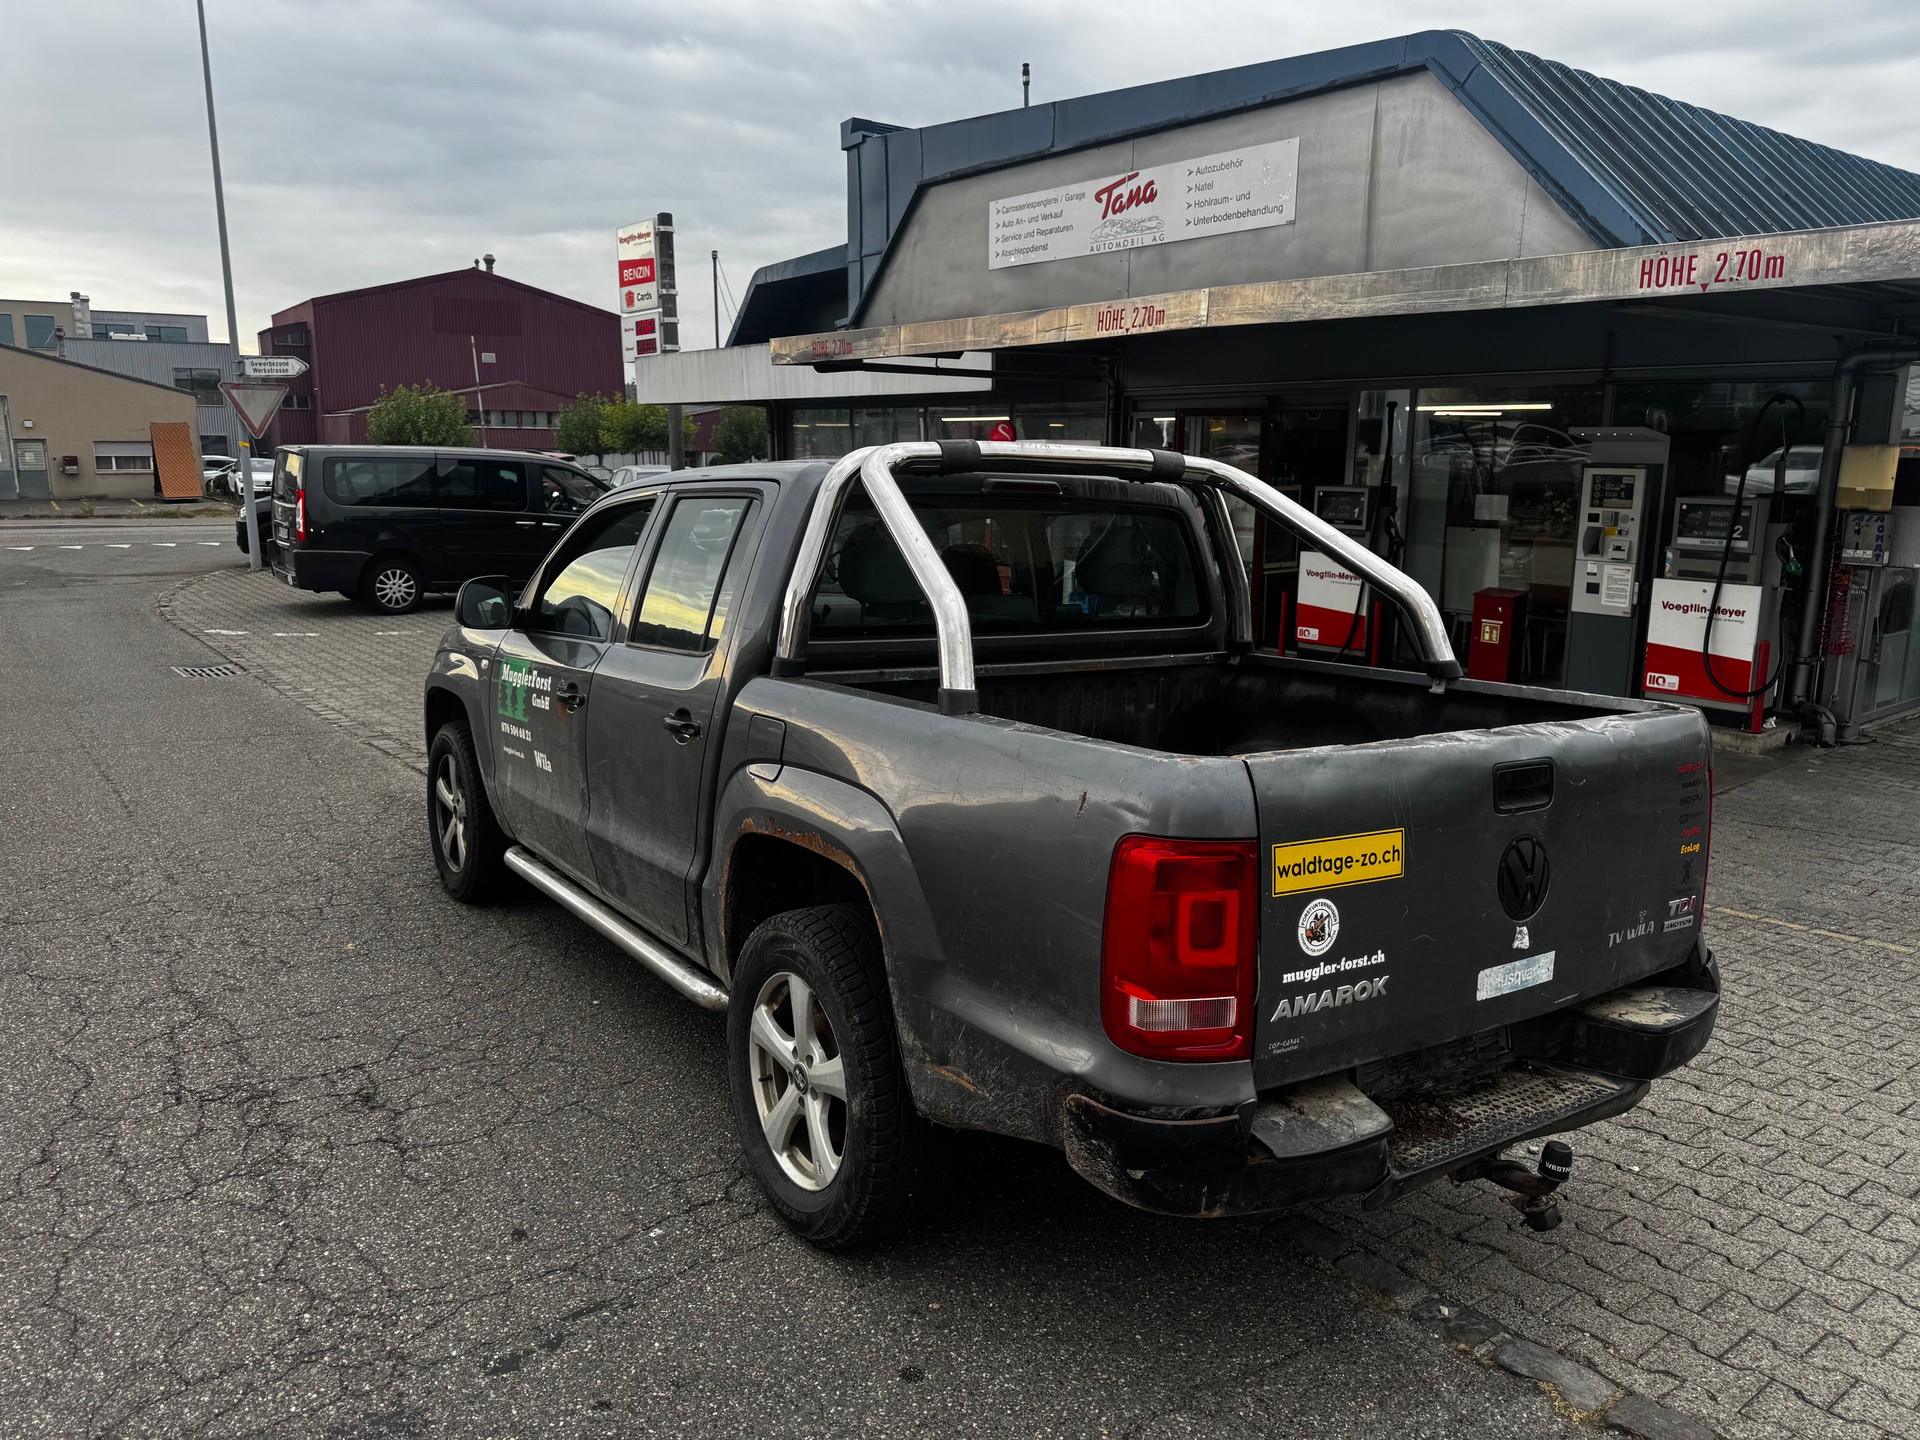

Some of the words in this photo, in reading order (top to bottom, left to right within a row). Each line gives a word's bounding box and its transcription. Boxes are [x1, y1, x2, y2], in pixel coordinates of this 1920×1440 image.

[1195, 159, 1243, 176] Autozubehör
[1094, 171, 1158, 220] Tana
[1194, 180, 1214, 192] Natel
[1001, 196, 1059, 214] Carrosseriespenglerei
[1064, 192, 1086, 202] Garage
[1194, 196, 1233, 209] Hohlraum-
[1236, 190, 1251, 202] und
[1001, 220, 1015, 229] Auto
[1015, 217, 1026, 225] An-
[1028, 214, 1039, 223] und
[1040, 209, 1064, 221] Verkauf
[1193, 204, 1284, 226] Unterbodenbehandlung
[1001, 234, 1022, 243] Service
[1024, 230, 1035, 239] und
[1036, 224, 1074, 237] Reparaturen
[1089, 237, 1144, 253] AUTOMOBIL
[1151, 233, 1165, 243] AG
[1001, 243, 1049, 258] Abschleppdienst
[623, 265, 651, 281] BENZIN
[1639, 250, 1699, 289] HÖHE
[636, 291, 652, 302] Cards
[1097, 306, 1125, 332] HÖHE
[812, 337, 829, 357] HÖHE
[1732, 525, 1743, 538] 2
[531, 693, 550, 710] GmbH
[533, 749, 552, 773] Wila
[1680, 843, 1700, 855] EcoLog
[1277, 844, 1400, 878] waldtage-zo.ch
[1301, 901, 1338, 926] FORSTUNTERNEHMER
[1668, 895, 1696, 917] TDI
[1608, 931, 1625, 949] TV
[1282, 949, 1386, 984] muggler-forst.ch
[1270, 975, 1390, 1023] AMAROK
